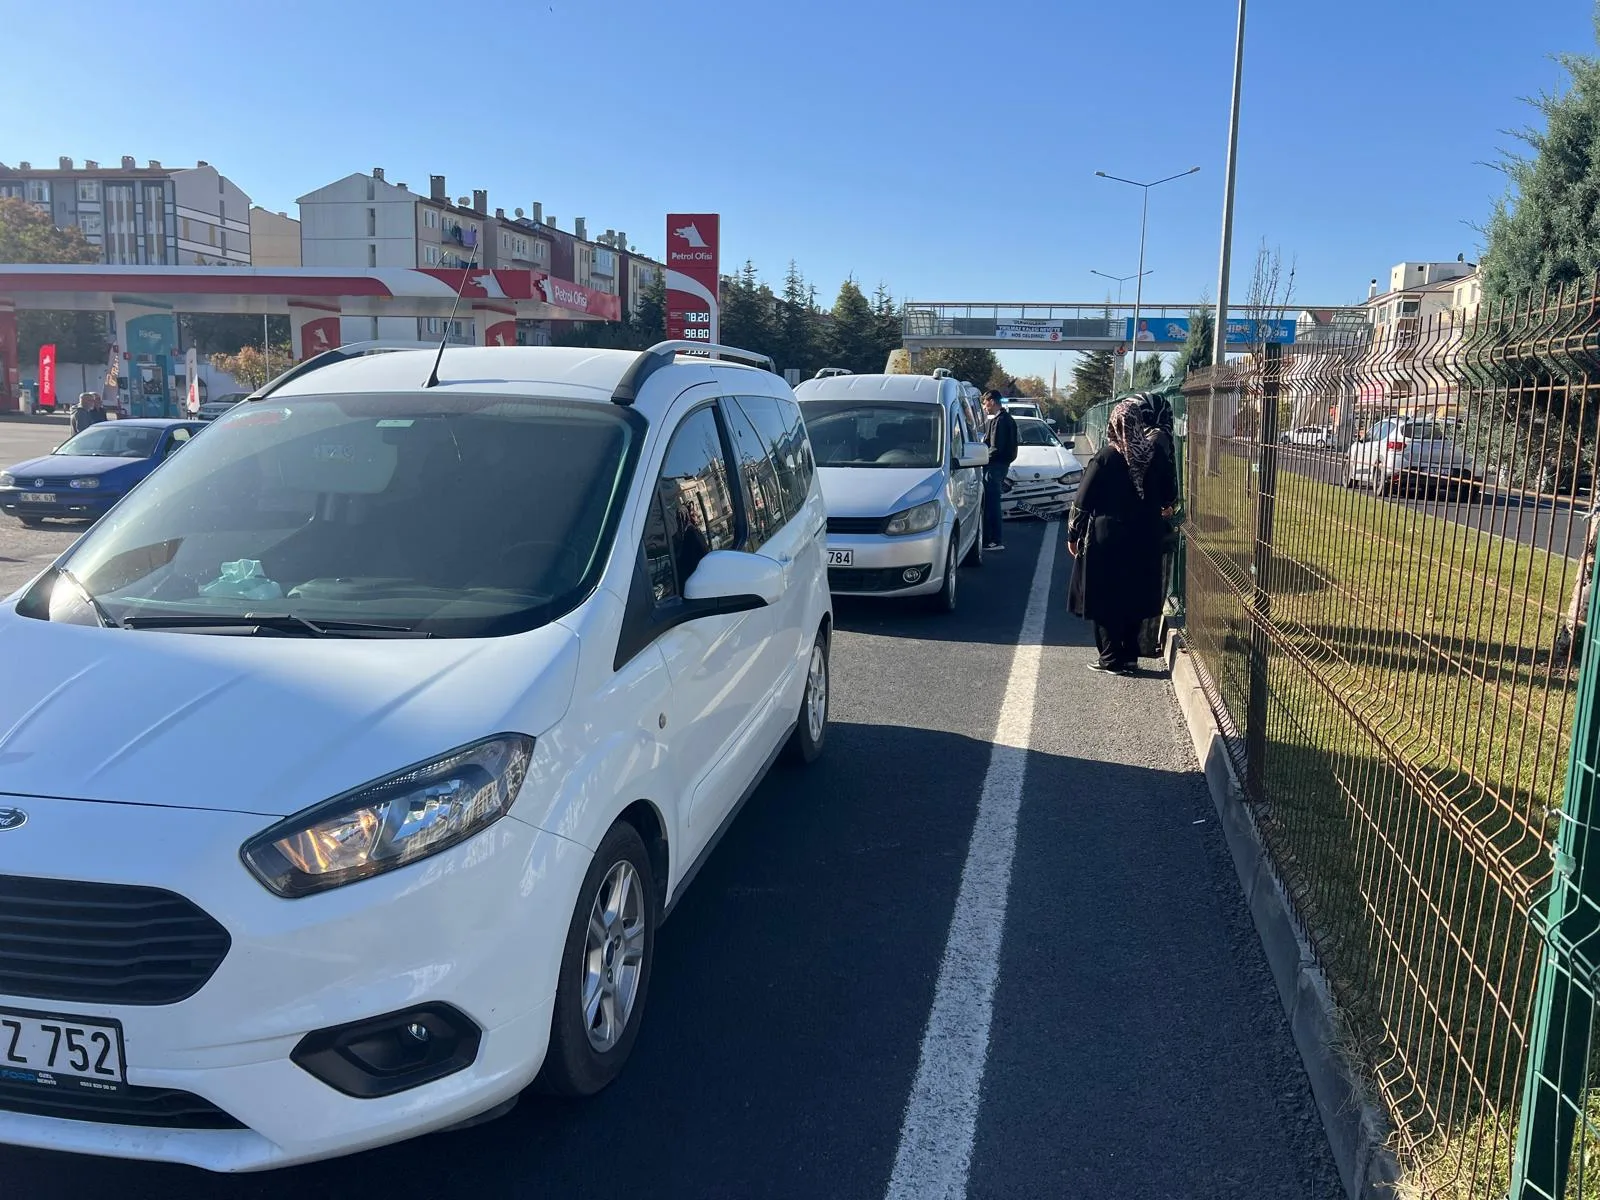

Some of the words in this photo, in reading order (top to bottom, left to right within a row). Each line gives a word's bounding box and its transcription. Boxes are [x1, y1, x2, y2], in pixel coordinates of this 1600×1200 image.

[672, 252, 694, 260] Petrol
[694, 252, 713, 260] Ofisi
[555, 286, 573, 303] Petrol
[573, 291, 588, 307] Ofisi
[828, 551, 850, 564] 784
[40, 1024, 115, 1076] 752
